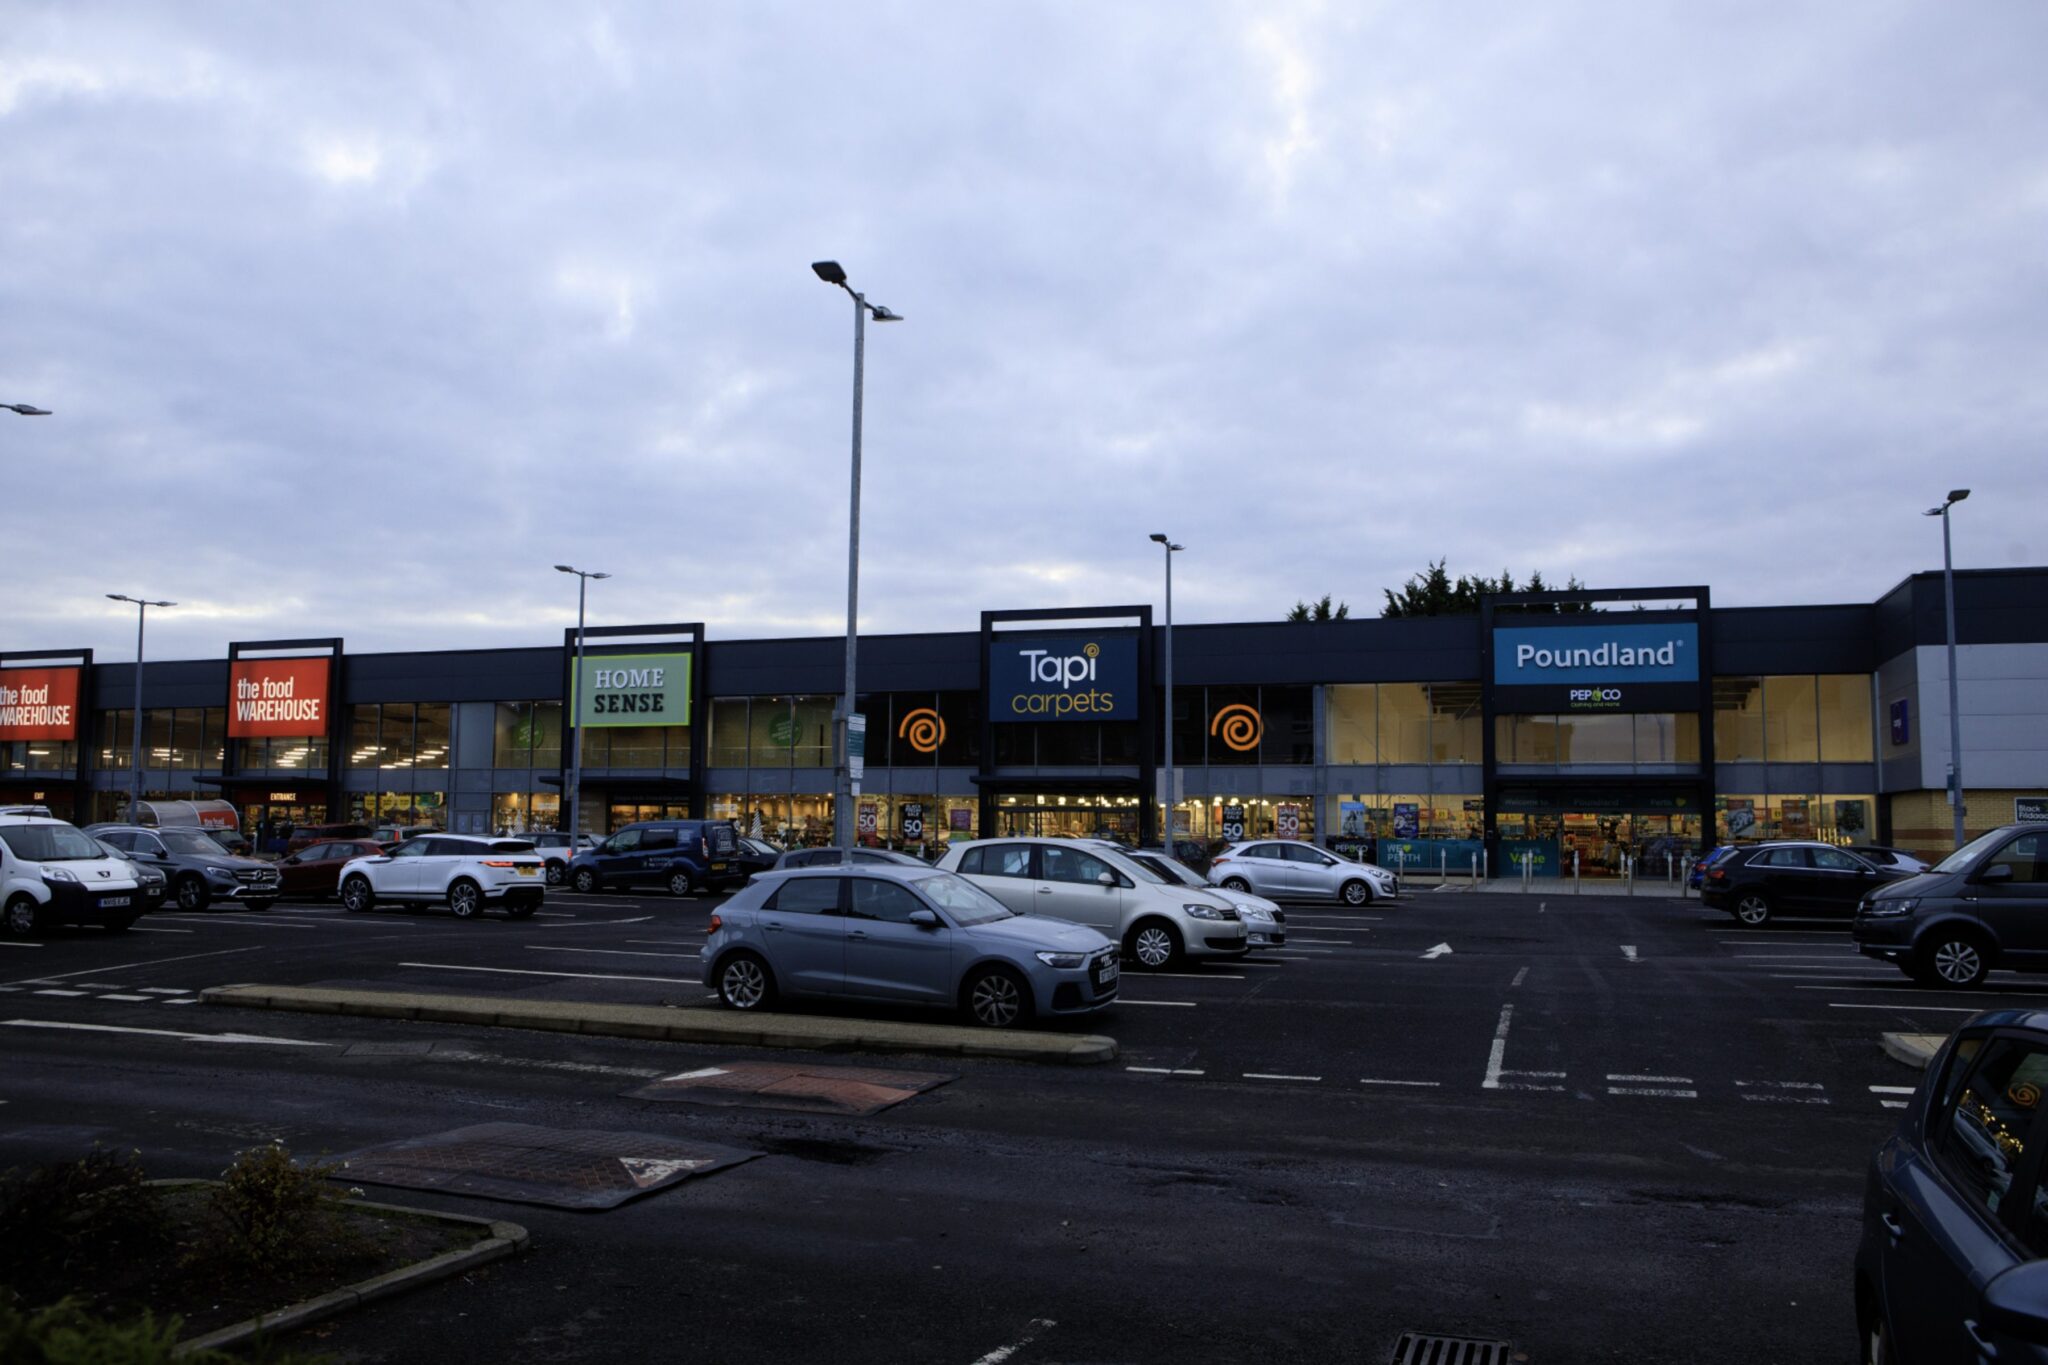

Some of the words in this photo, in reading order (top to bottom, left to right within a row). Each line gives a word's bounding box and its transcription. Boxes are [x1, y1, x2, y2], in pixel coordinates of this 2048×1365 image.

[1019, 643, 1100, 689] Tapi
[237, 678, 260, 699] the
[262, 676, 294, 698] food
[594, 668, 664, 689] HOME
[0, 685, 18, 705] the
[21, 684, 49, 705] food
[594, 693, 664, 713] SENSE
[1012, 688, 1114, 717] carpets
[0, 705, 71, 726] WAREHOUSE
[237, 698, 320, 721] WAREHOUSE
[269, 792, 297, 801] ENTRANCE
[859, 815, 877, 827] 50
[904, 820, 922, 832] 50
[1223, 822, 1243, 836] 50
[1278, 816, 1299, 830] 50
